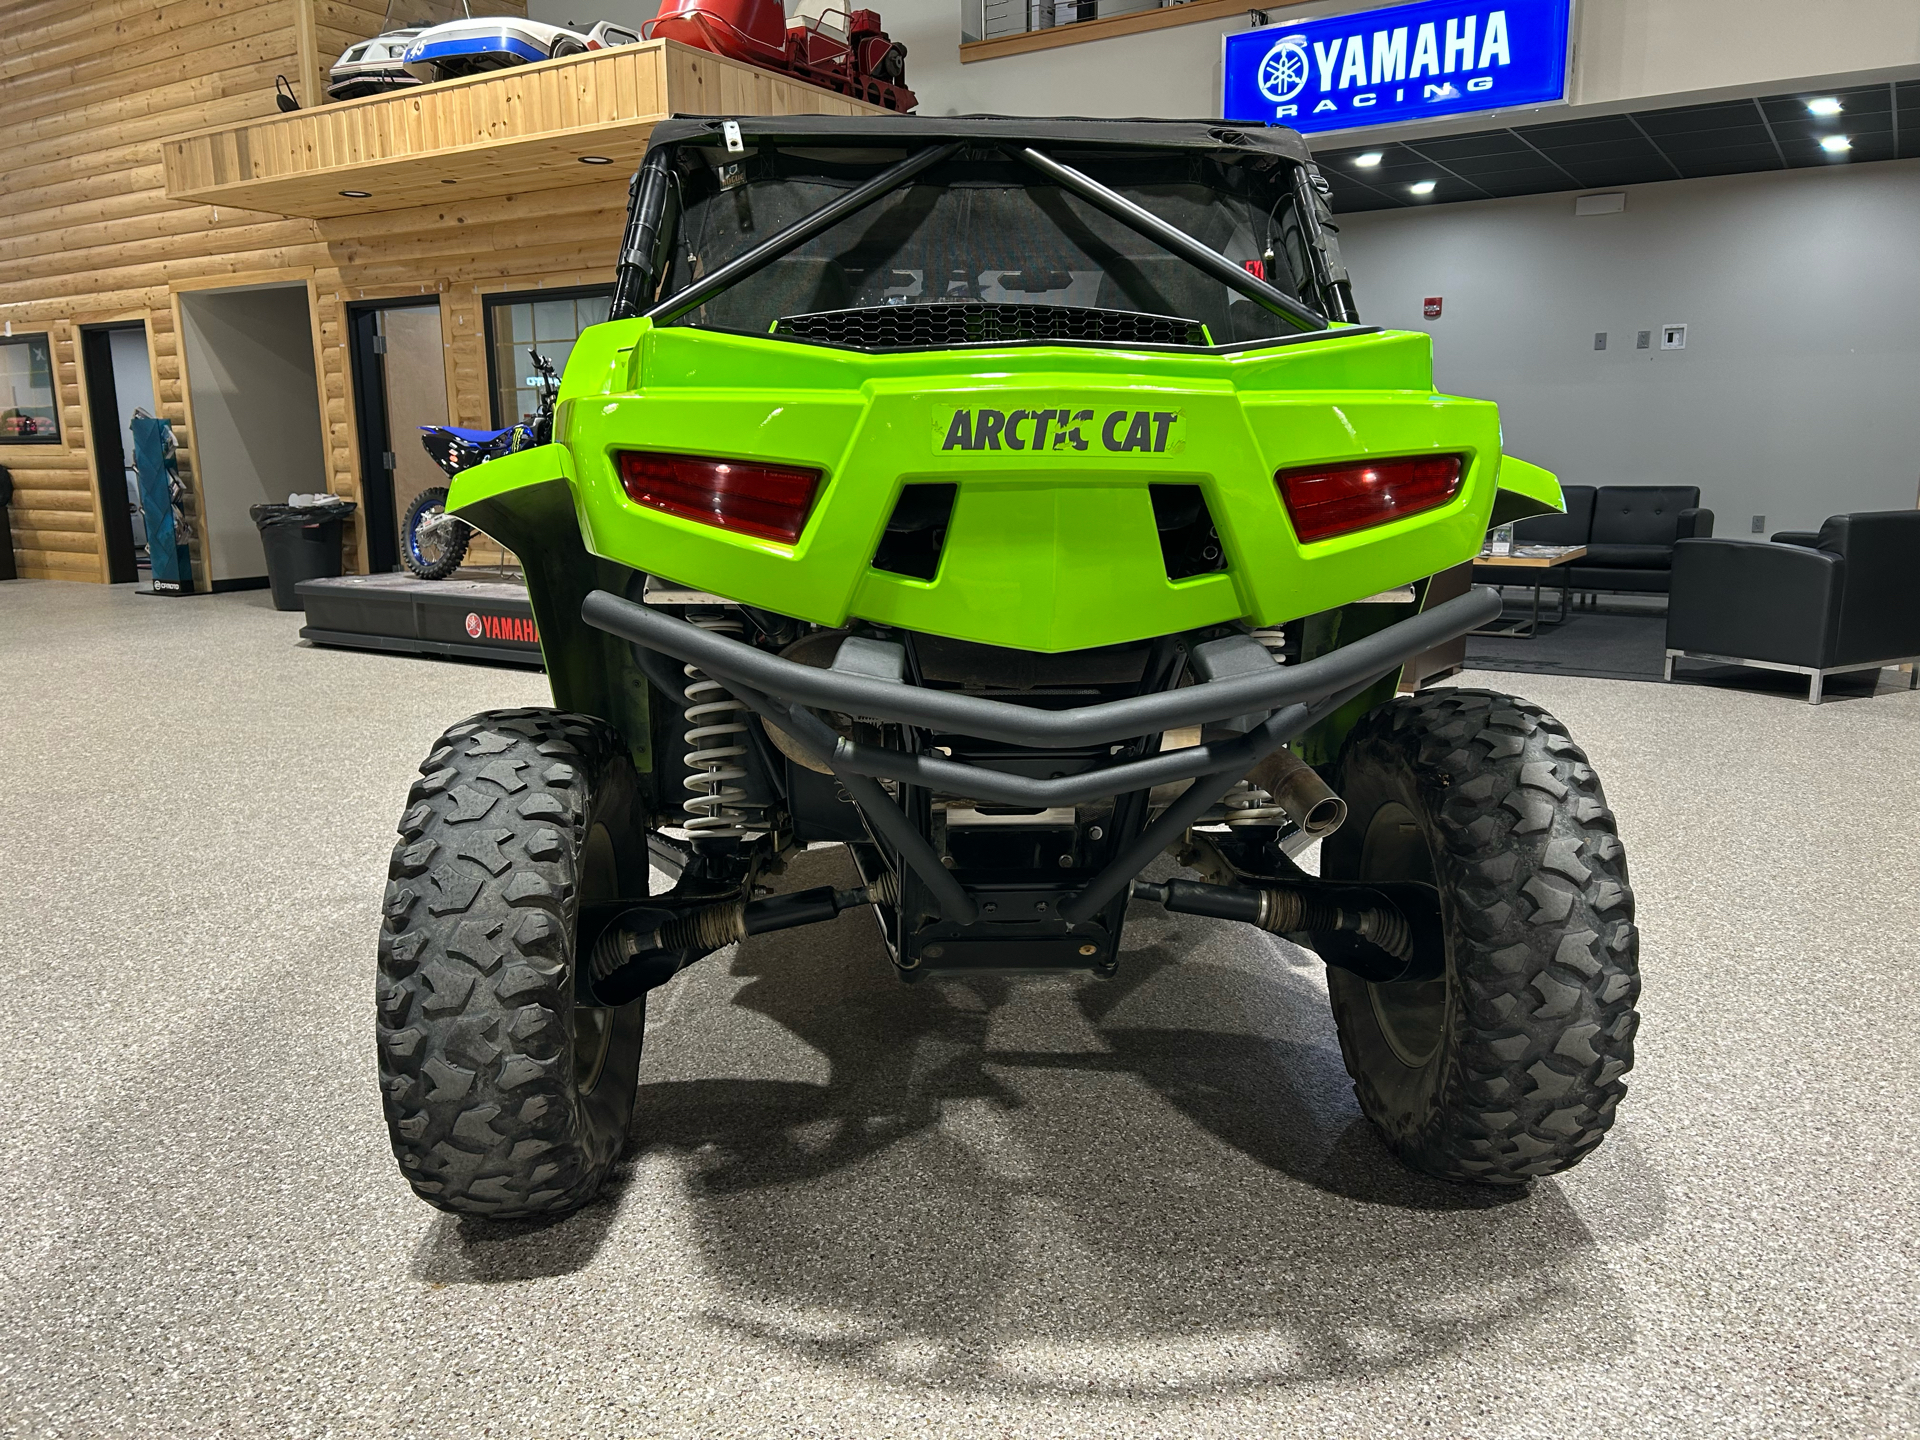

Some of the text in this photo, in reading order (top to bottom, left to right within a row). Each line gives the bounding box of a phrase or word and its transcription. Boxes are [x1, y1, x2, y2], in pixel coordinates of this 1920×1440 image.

[1312, 10, 1511, 92] YAMAHA
[1275, 76, 1494, 119] RACING
[1245, 260, 1267, 282] EXI
[941, 409, 1178, 453] ARCTIC CAT
